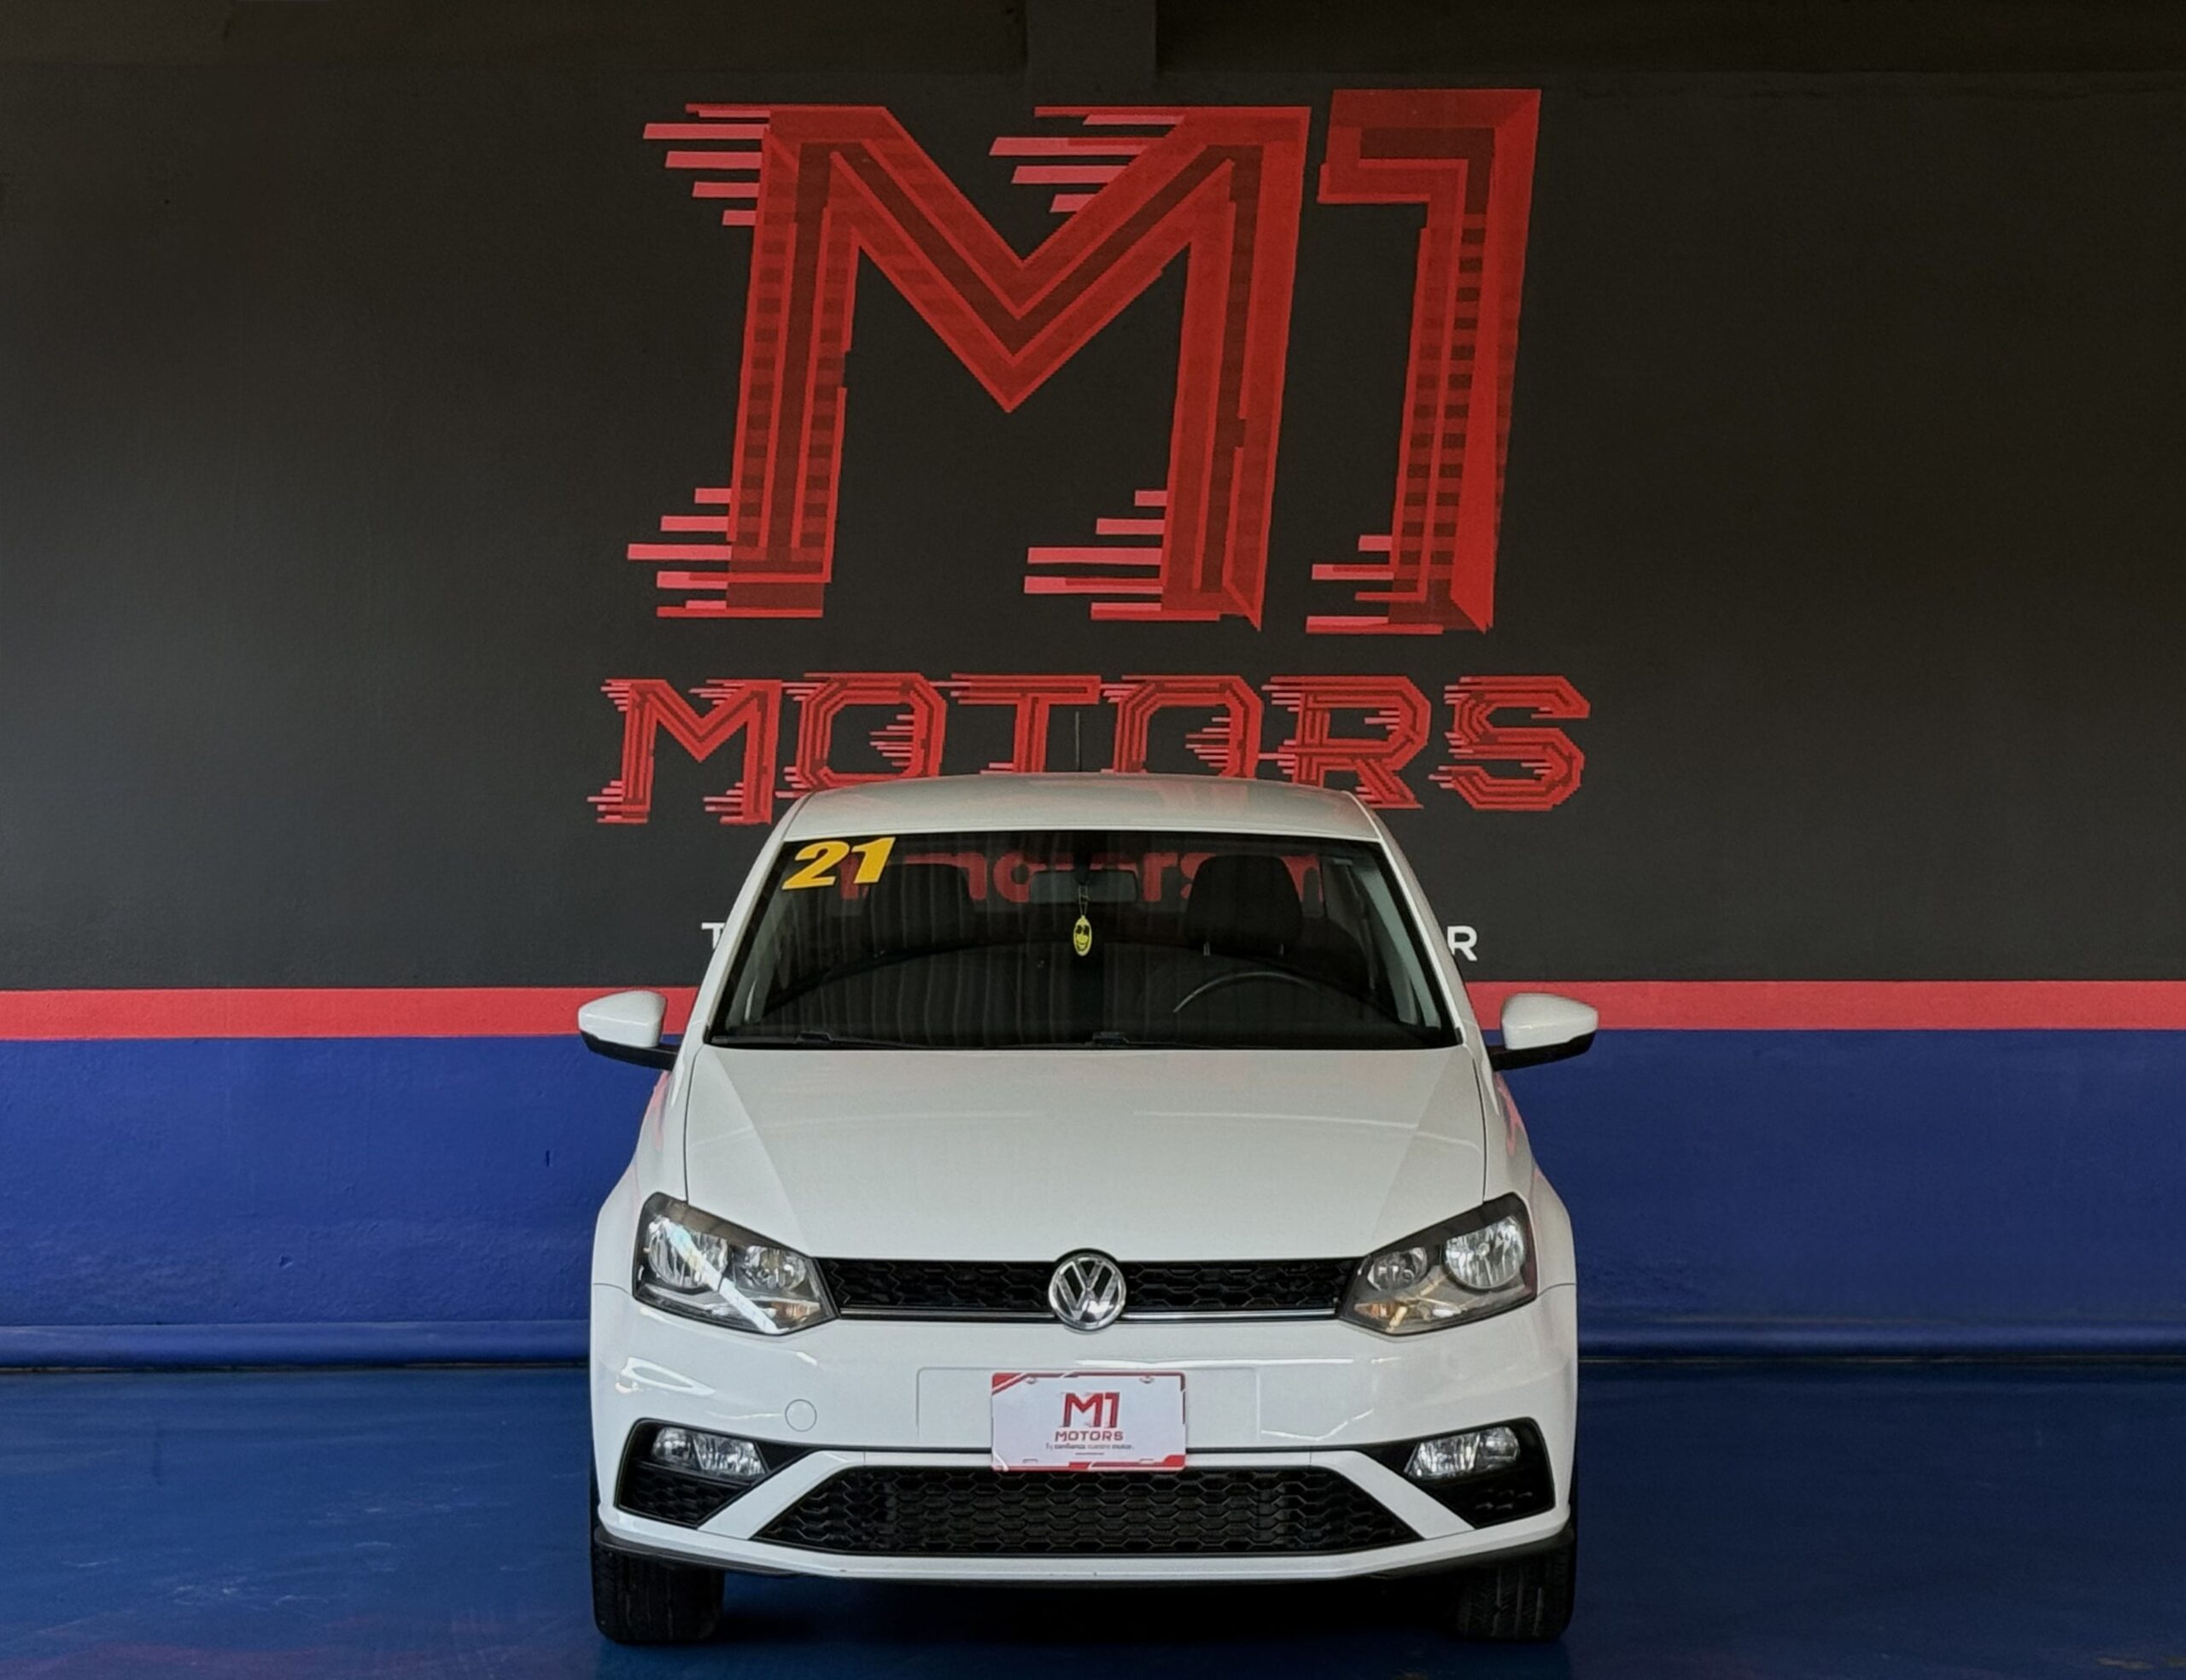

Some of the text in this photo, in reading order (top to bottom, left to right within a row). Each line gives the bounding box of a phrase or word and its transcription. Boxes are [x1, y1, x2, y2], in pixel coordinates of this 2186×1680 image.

[627, 87, 1541, 634] M1
[587, 673, 1591, 825] MOTORS
[780, 837, 896, 890] 21
[1060, 1391, 1120, 1428] M1
[1055, 1431, 1124, 1442] MOTORS
